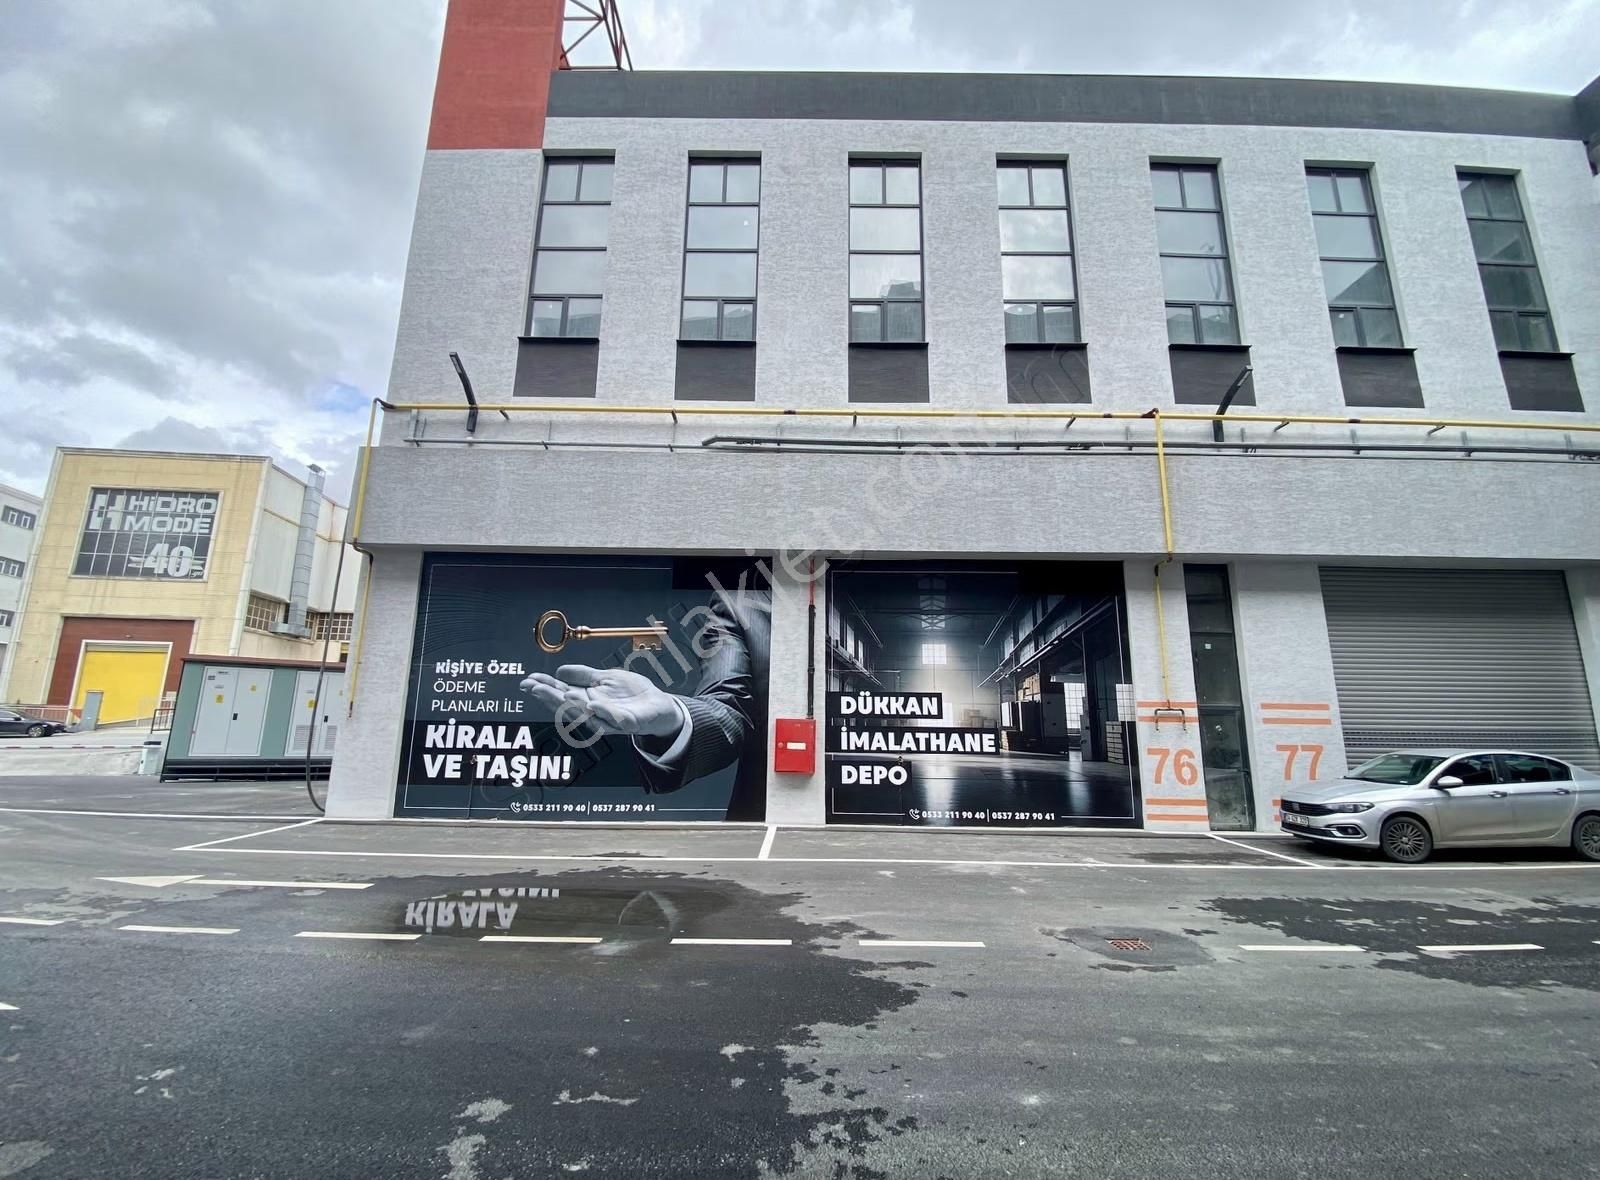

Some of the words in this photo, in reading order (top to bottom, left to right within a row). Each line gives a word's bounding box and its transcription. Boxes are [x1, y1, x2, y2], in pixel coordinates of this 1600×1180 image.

[124, 515, 212, 534] MODE
[146, 543, 193, 577] 40
[435, 659, 484, 678] KİŞİYE
[487, 660, 526, 675] ÖZEL
[433, 678, 487, 693] ÖDEME
[431, 699, 499, 713] PLANLARI
[503, 698, 524, 713] İLE
[840, 691, 938, 716] DÜKKAN
[425, 717, 534, 750] KİRALA
[840, 726, 996, 753] İMALATHANE
[423, 754, 463, 779] VE
[475, 755, 571, 788] TAŞIN!
[1147, 748, 1199, 787] 76
[1276, 744, 1324, 781] 77
[841, 765, 908, 786] DEPO
[523, 804, 543, 812] 0533
[545, 804, 561, 812] 211
[563, 804, 574, 812] 90
[575, 804, 586, 812] 40
[592, 804, 613, 812] 0537
[615, 804, 631, 812] 287
[633, 804, 643, 812] 90
[645, 804, 655, 812] 41
[945, 811, 960, 819] 211
[962, 811, 973, 819] 90
[975, 811, 985, 819] 40
[992, 812, 1012, 820] 0537
[1015, 812, 1030, 820] 287
[1033, 812, 1043, 820] 90
[1045, 812, 1055, 820] 41
